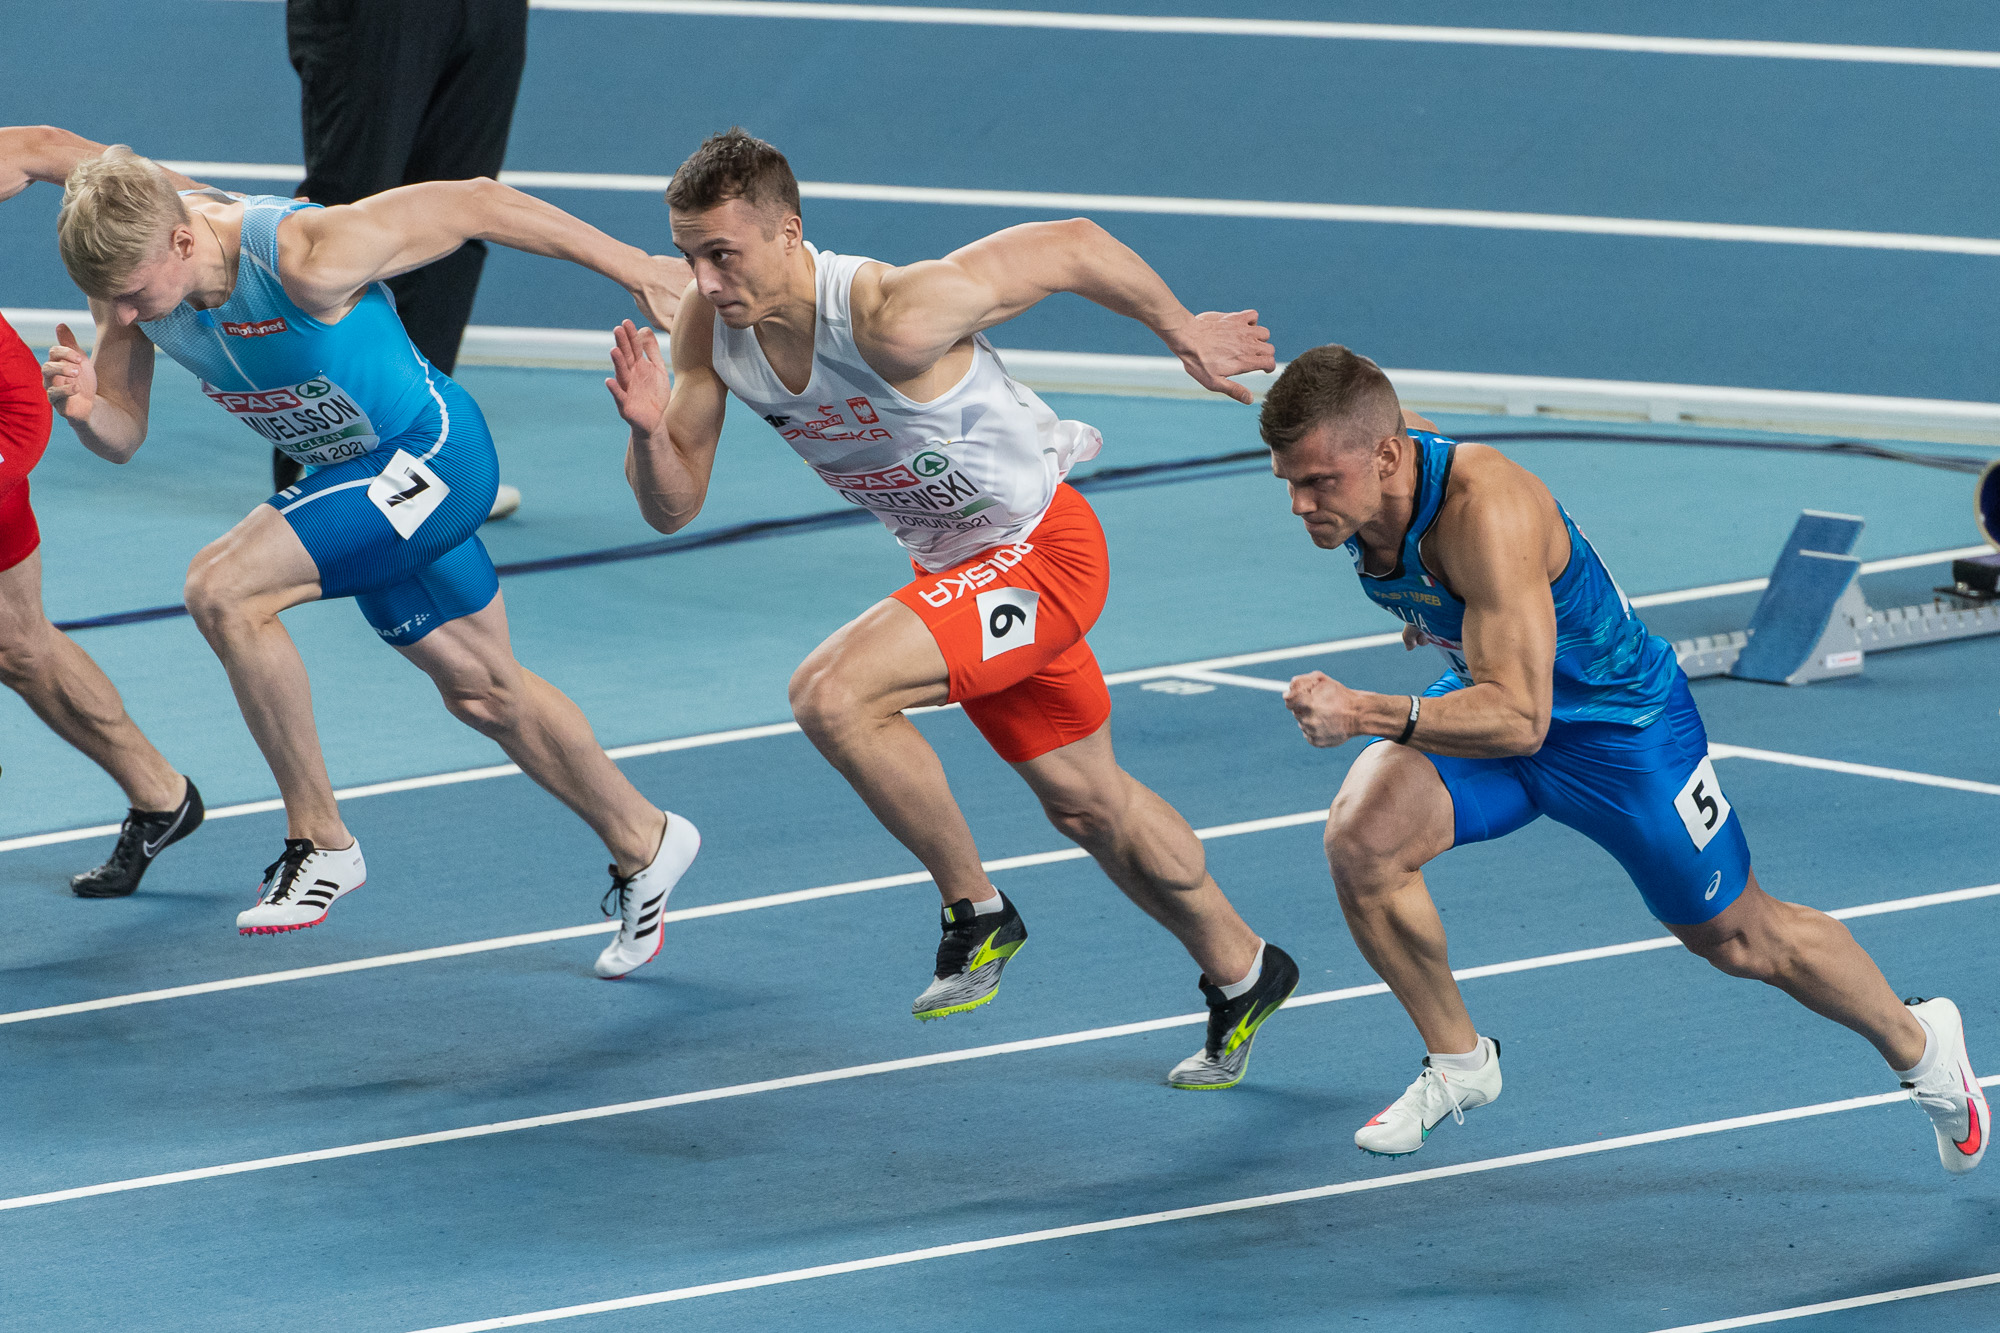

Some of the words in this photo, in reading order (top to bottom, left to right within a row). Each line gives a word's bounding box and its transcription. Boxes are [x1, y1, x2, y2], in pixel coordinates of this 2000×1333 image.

[227, 321, 285, 336] motonet
[240, 394, 361, 442] MUELSSON
[808, 415, 843, 430] ORLEN
[328, 441, 368, 460] 2021
[385, 466, 431, 508] 7
[822, 469, 916, 488] SPAR
[839, 470, 980, 511] OLSZEWSKI
[951, 514, 993, 531] 2021
[918, 541, 1035, 608] POLSKA
[373, 619, 412, 637] RAFT
[989, 603, 1027, 639] 6
[1691, 779, 1719, 831] 5
